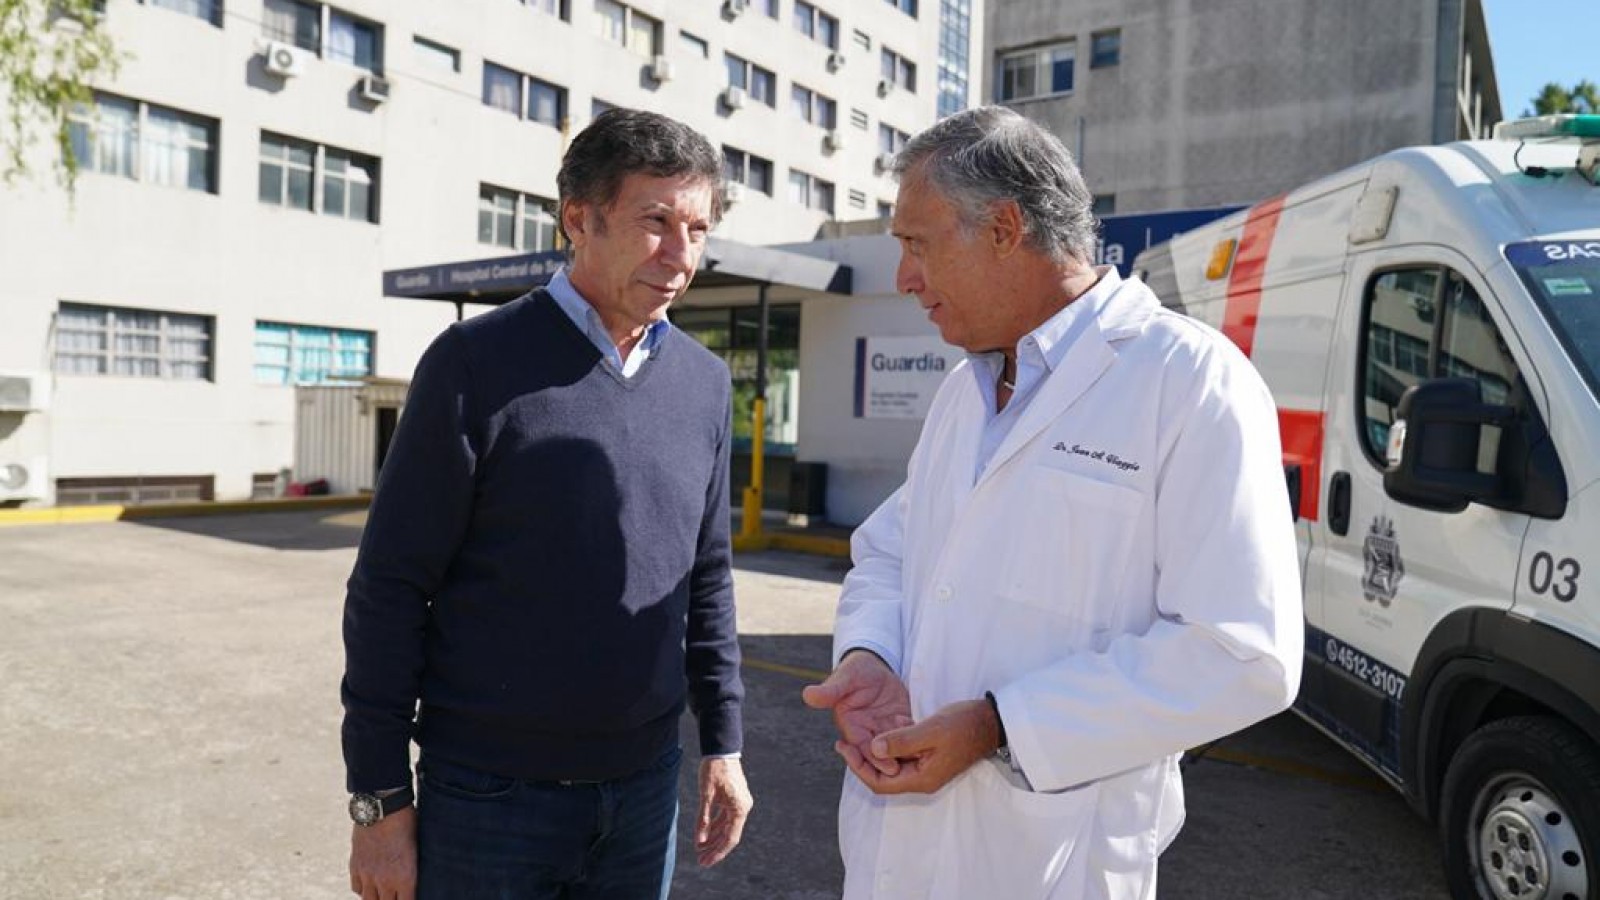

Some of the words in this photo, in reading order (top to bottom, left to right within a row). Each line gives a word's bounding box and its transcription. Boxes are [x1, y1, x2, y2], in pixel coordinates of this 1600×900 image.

[492, 264, 528, 279] Central
[871, 352, 946, 373] Guardia
[1529, 551, 1581, 603] 03
[1338, 646, 1406, 700] 4512-3107
